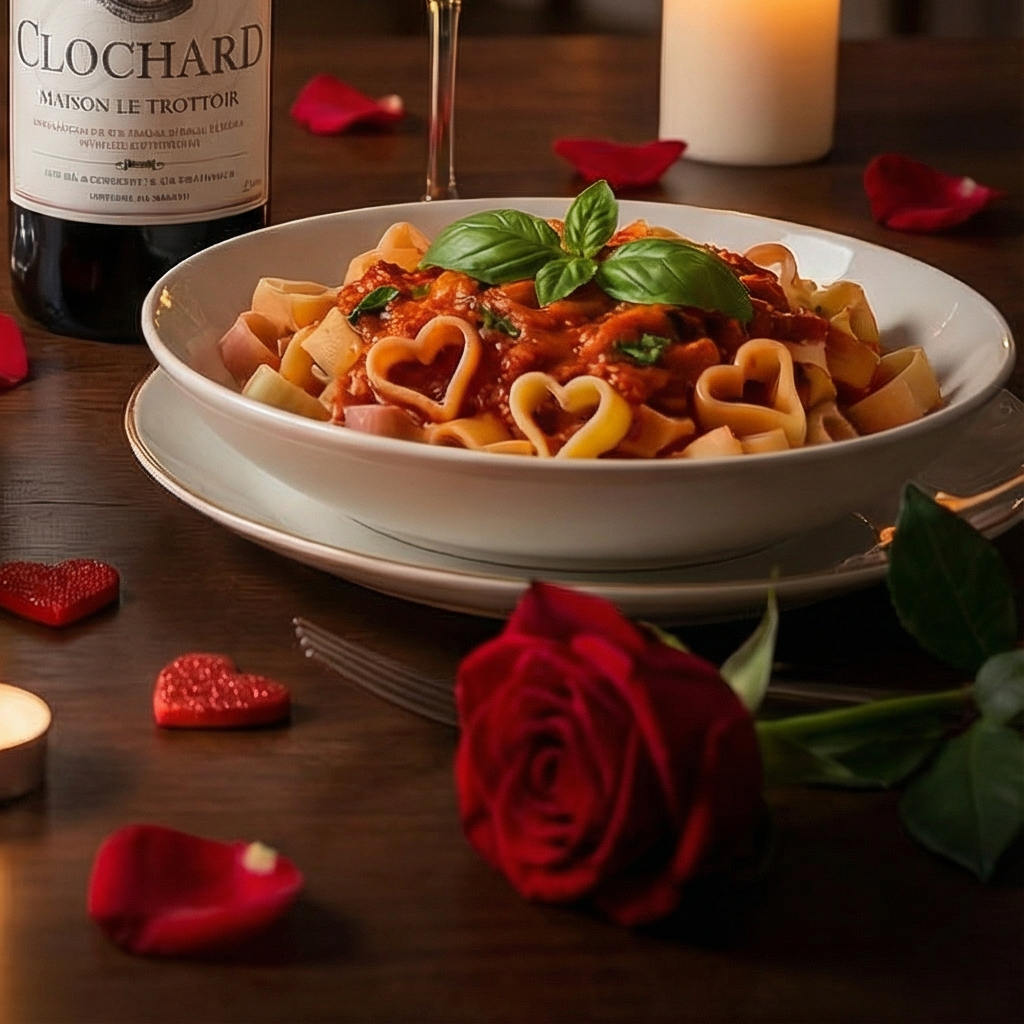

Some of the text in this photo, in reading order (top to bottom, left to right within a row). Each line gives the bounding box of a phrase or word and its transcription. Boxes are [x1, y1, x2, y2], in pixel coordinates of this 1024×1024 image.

[17, 20, 264, 79] CLOCHARD
[39, 90, 240, 114] MAISON LE TROTTOIR
